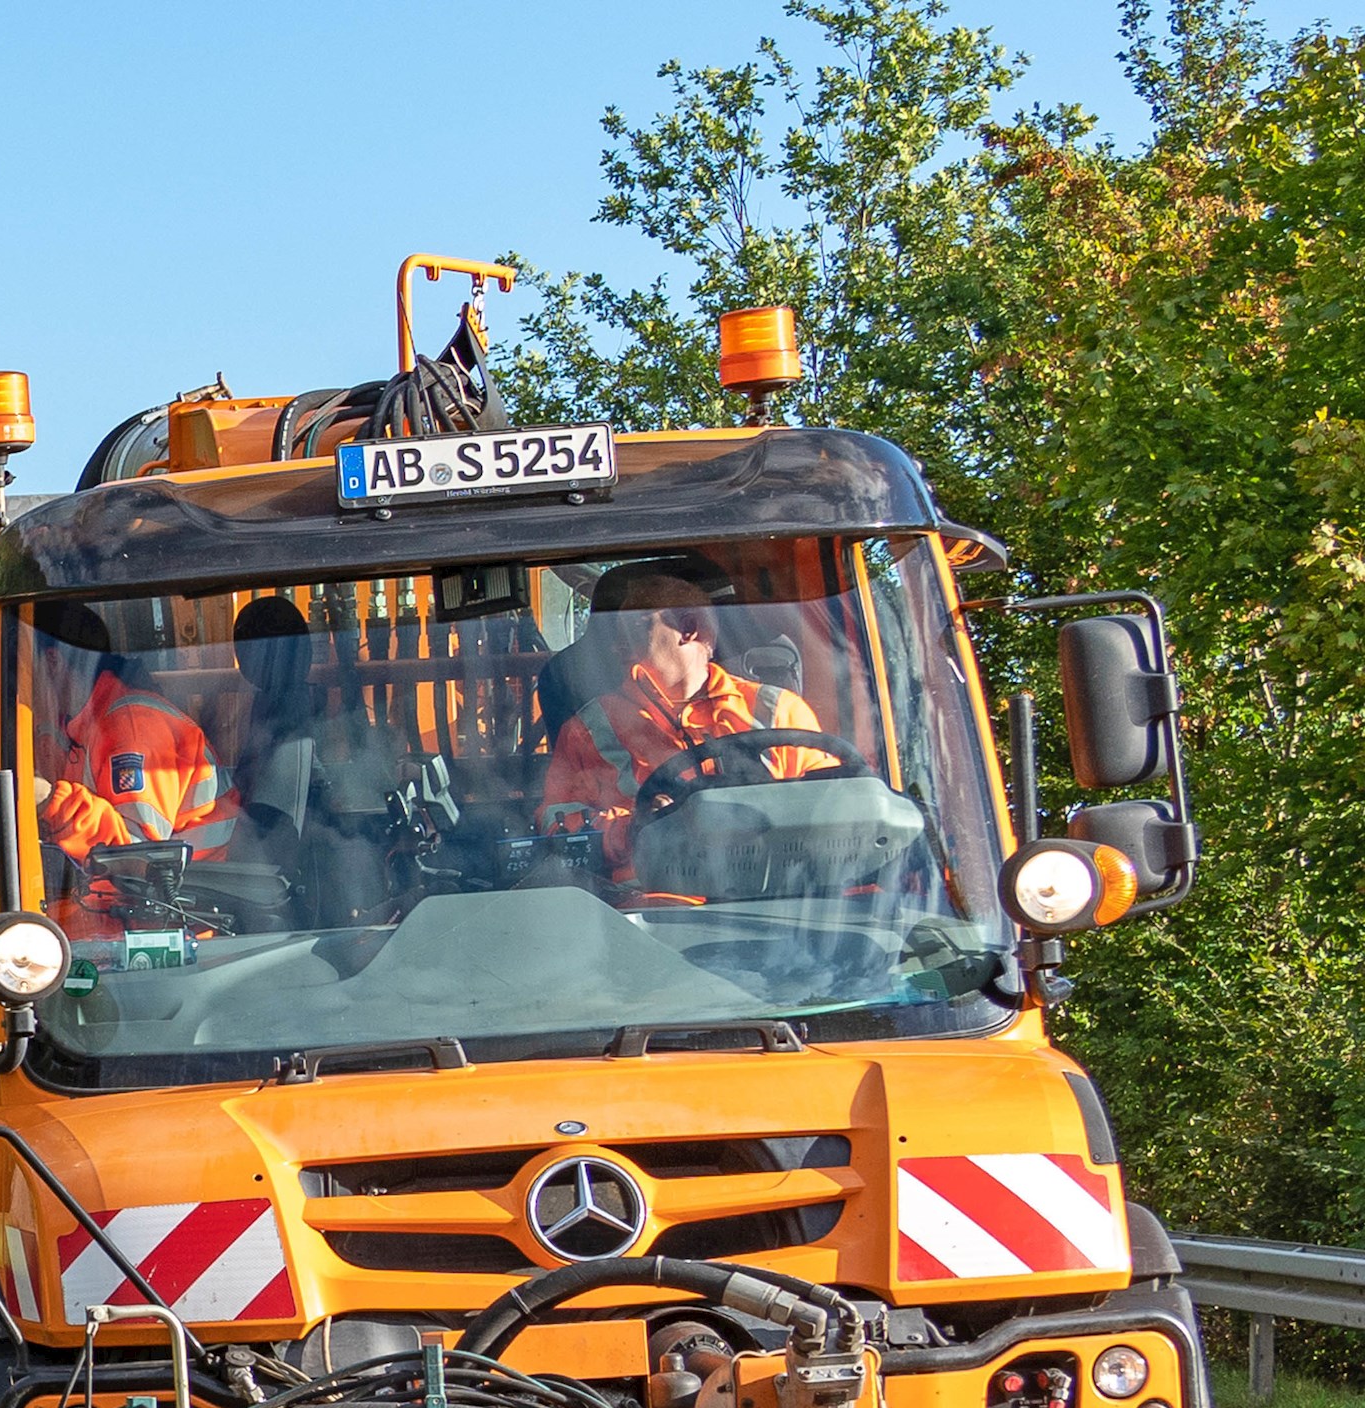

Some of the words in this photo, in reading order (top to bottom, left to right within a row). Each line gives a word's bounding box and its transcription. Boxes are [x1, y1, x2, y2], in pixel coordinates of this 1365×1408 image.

[348, 476, 359, 489] D
[370, 448, 425, 491] AB
[457, 442, 484, 482] S
[494, 432, 603, 479] 5254
